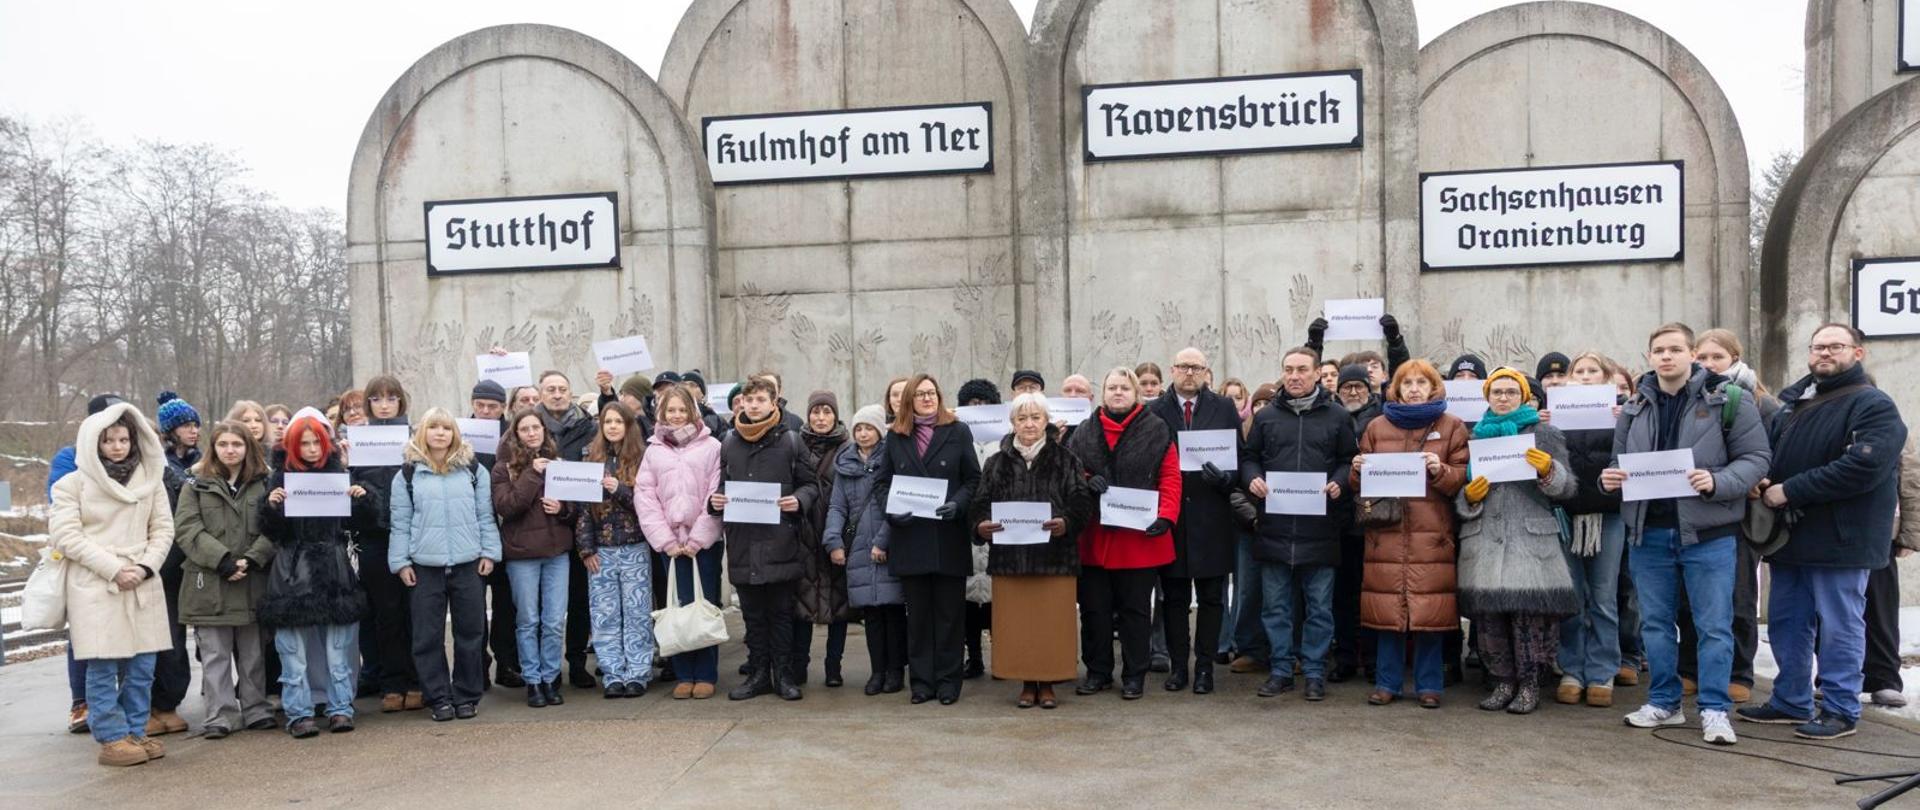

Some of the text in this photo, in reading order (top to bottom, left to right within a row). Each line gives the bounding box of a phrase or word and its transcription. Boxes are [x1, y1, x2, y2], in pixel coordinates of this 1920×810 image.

[1099, 91, 1341, 137] Ravensbrück
[717, 121, 980, 165] Kulmhof am Ner
[1440, 182, 1664, 215] Sachsenhausen
[445, 211, 594, 252] Stutthof
[1458, 219, 1646, 251] Oranienburg
[1555, 402, 1609, 410] #WeRemember
[1629, 468, 1687, 477] #WeRemember
[896, 490, 940, 499] #WeRemember
[1107, 502, 1152, 512] #WeRemember
